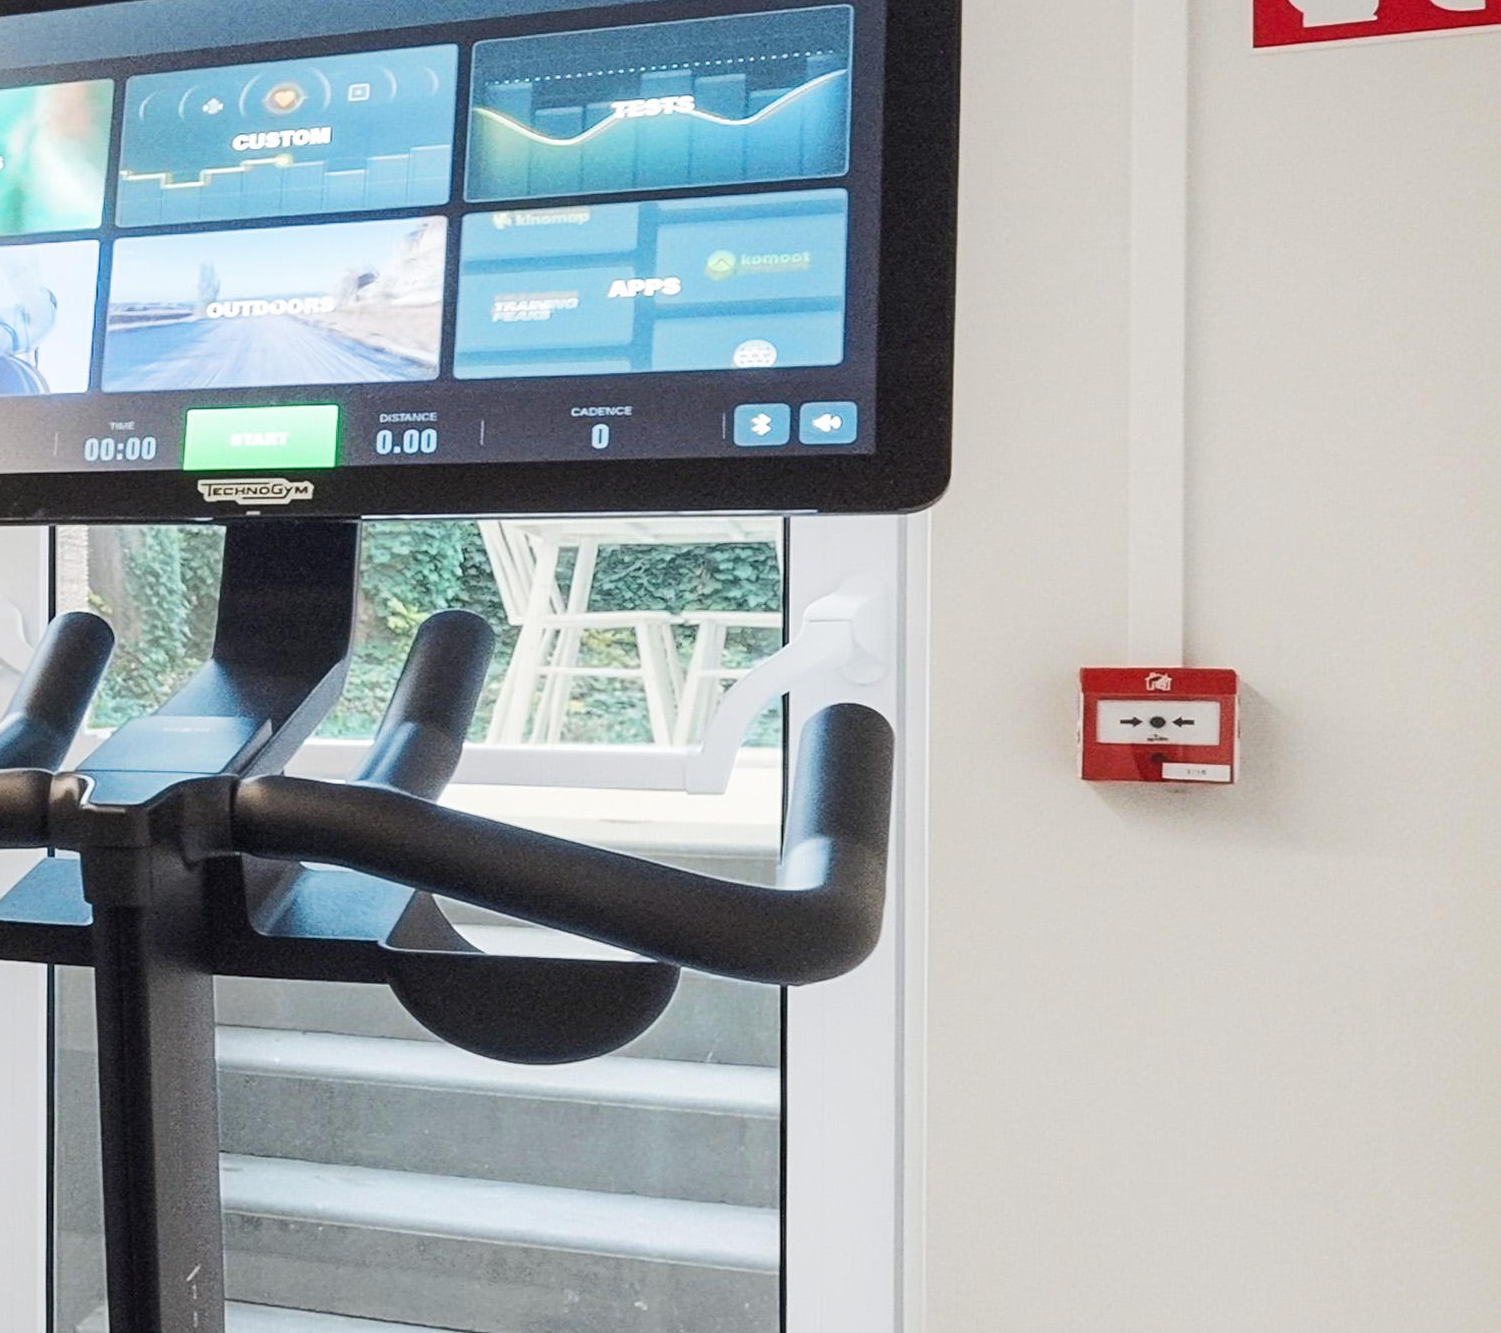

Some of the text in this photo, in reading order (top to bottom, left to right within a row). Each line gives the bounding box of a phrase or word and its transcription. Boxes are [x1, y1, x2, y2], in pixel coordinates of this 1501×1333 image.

[610, 95, 696, 120] TESTS
[231, 126, 332, 152] CUSTOM
[515, 209, 591, 227] kinomap
[740, 250, 811, 266] komoot
[607, 276, 683, 299] APPS
[205, 296, 335, 321] OUTDOORS
[379, 412, 438, 424] DISTANCE
[571, 406, 633, 417] CADENCE
[109, 421, 135, 432] TIME
[591, 423, 610, 450] 0
[84, 436, 158, 462] 00:00
[230, 432, 289, 447] START
[375, 428, 438, 455] 0.00
